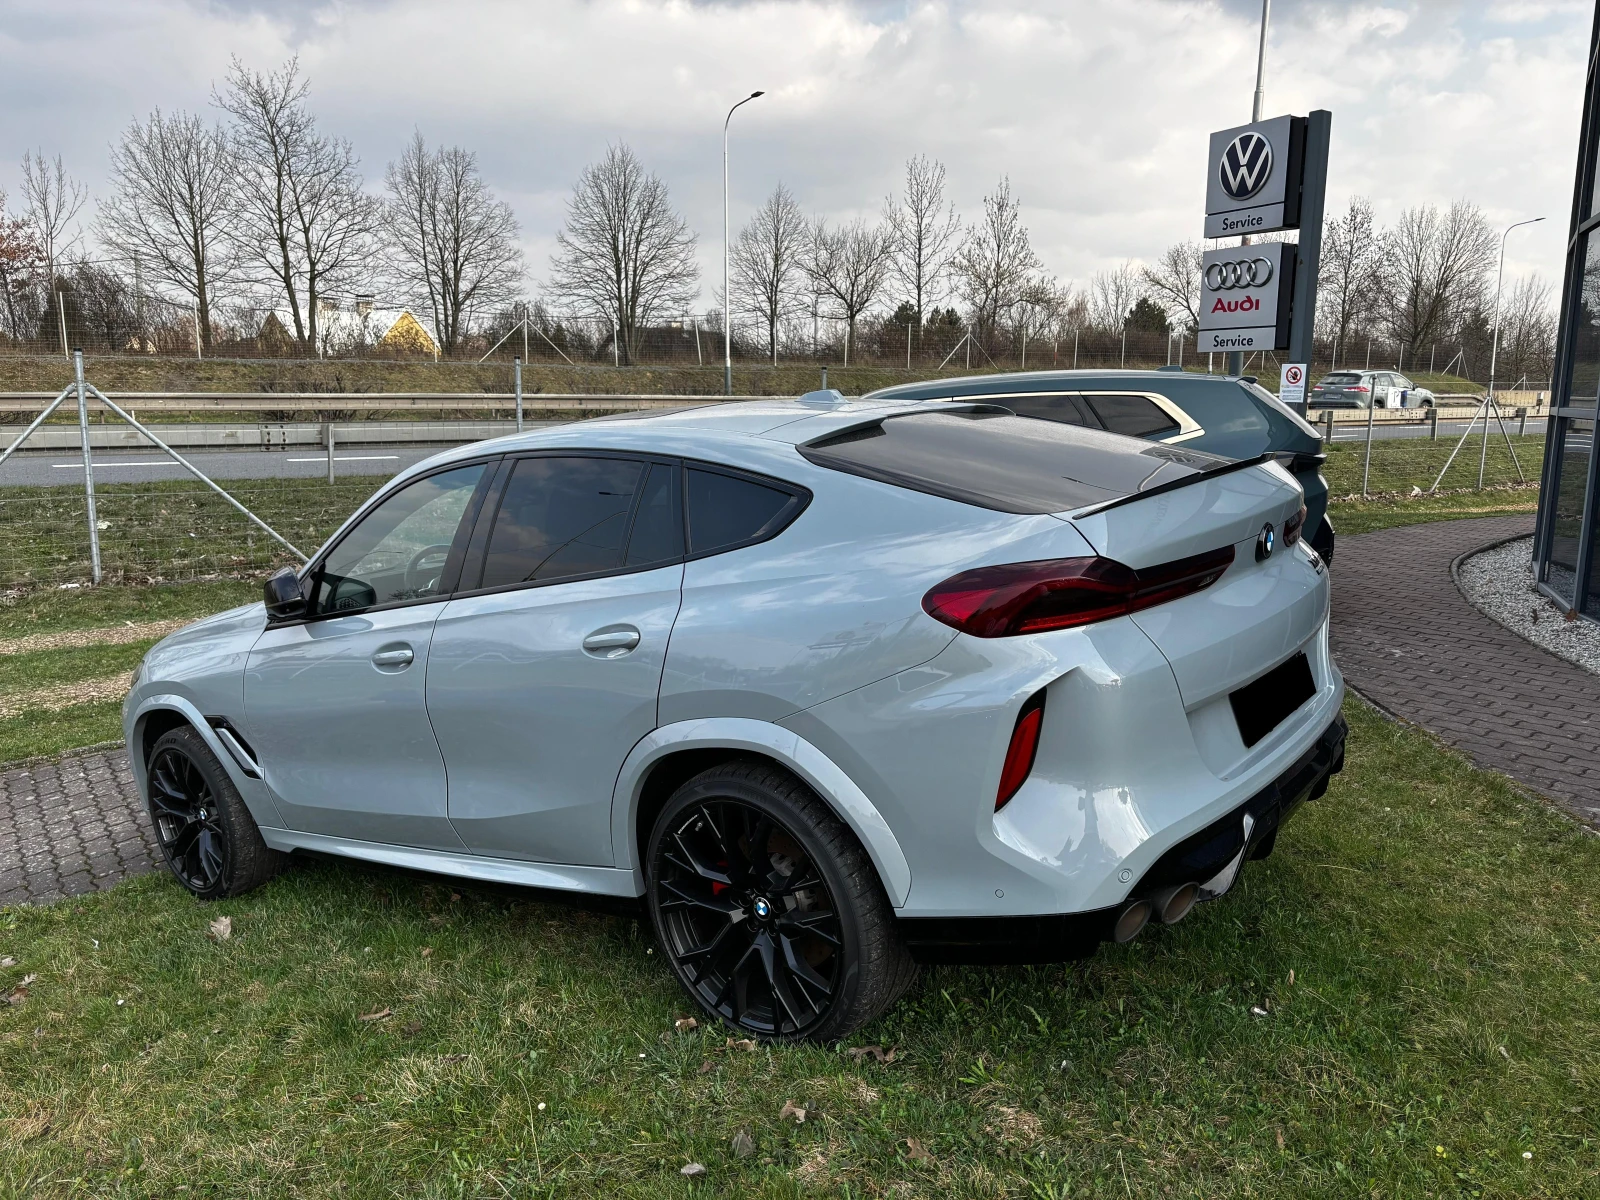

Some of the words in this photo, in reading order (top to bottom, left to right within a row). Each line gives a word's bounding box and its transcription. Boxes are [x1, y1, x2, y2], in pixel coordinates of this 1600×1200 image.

[1220, 133, 1271, 196] VW
[1222, 214, 1263, 231] Service
[1211, 295, 1260, 314] Audi
[1213, 334, 1254, 348] Service
